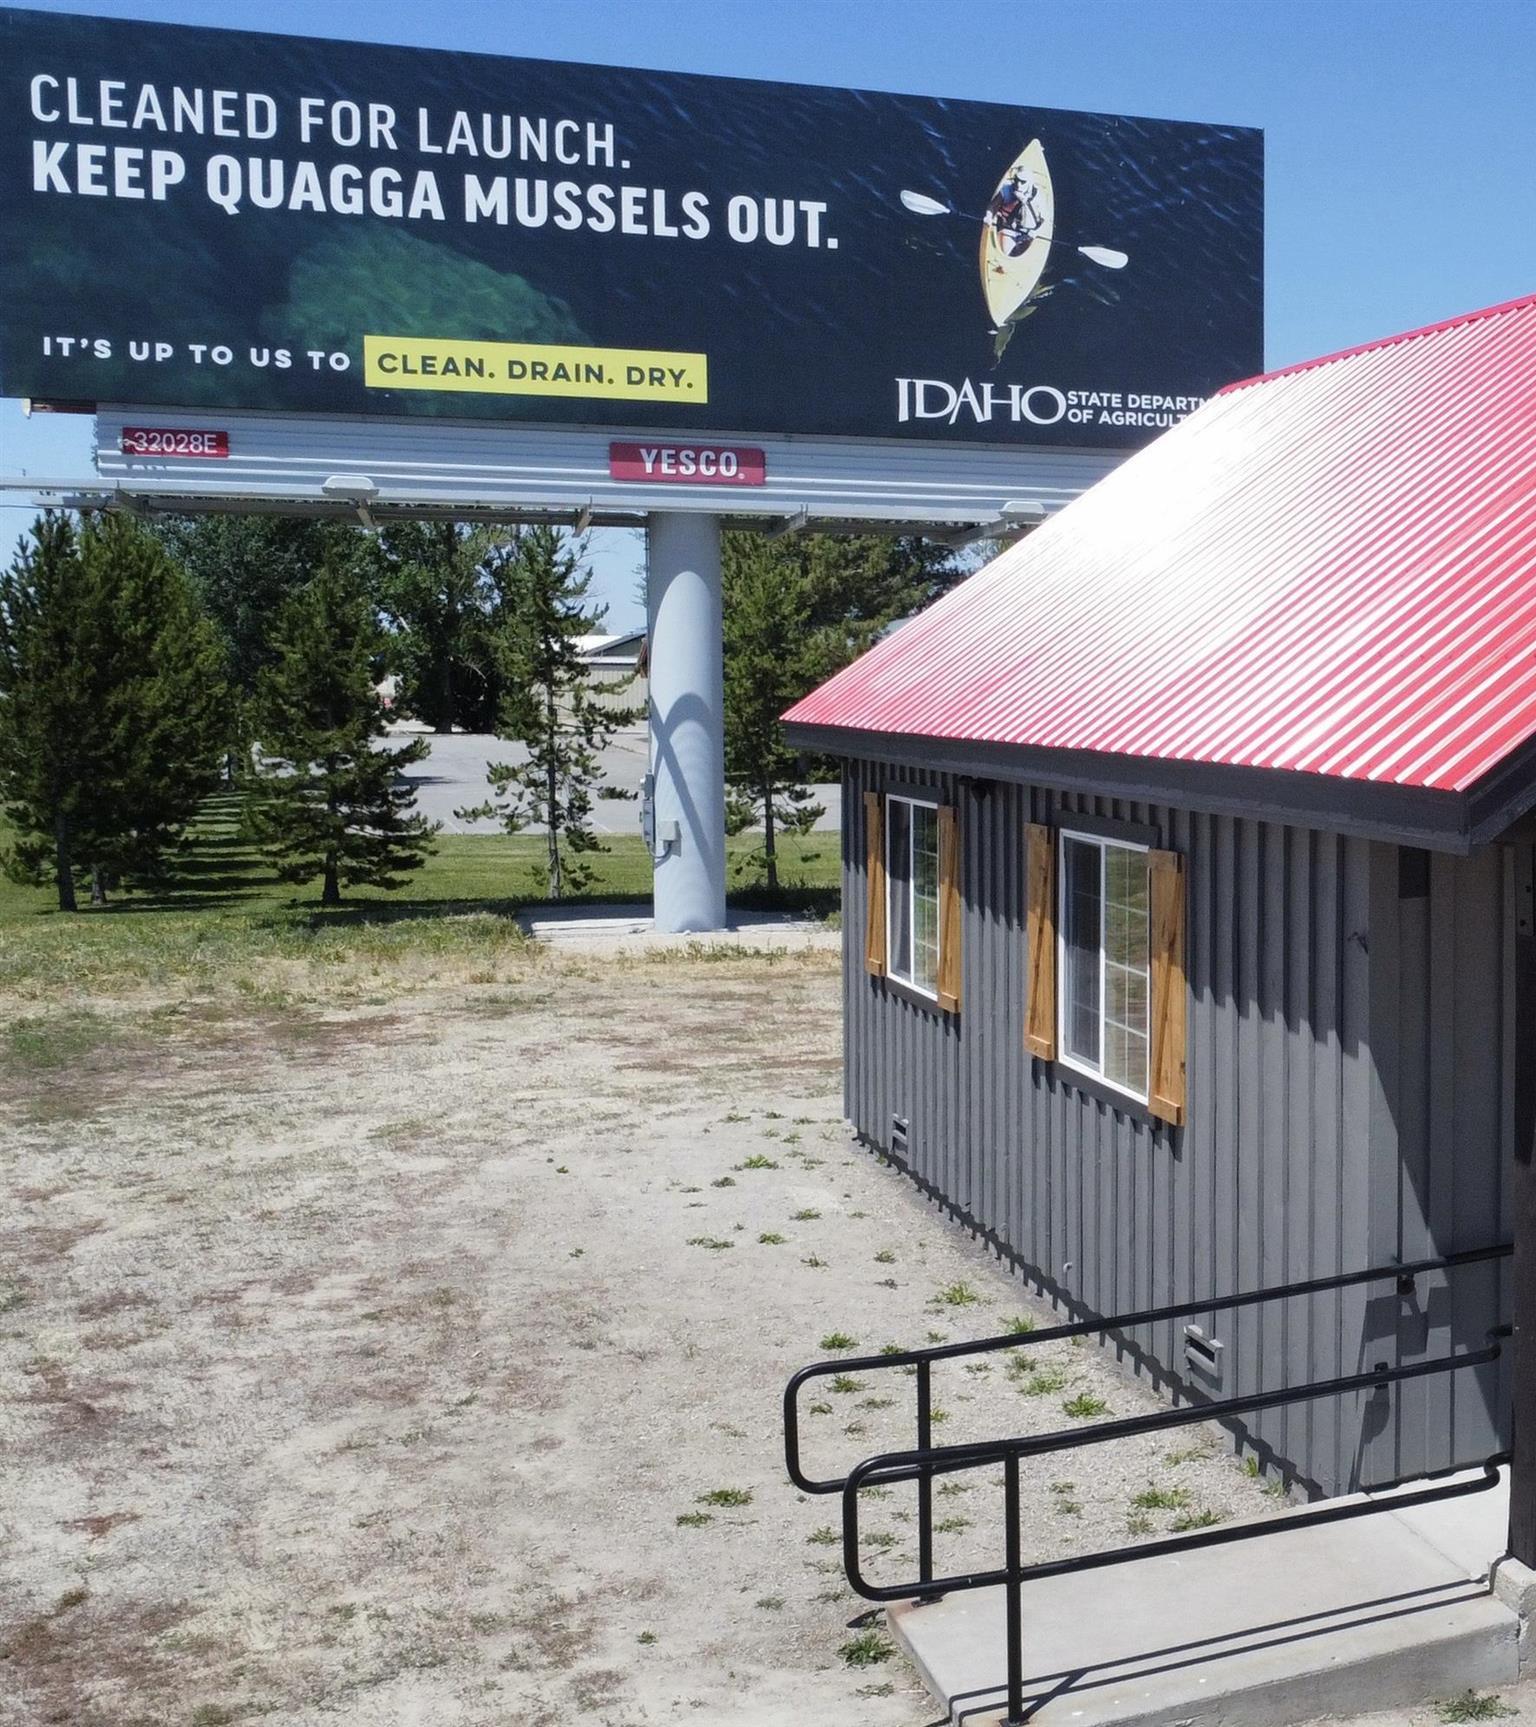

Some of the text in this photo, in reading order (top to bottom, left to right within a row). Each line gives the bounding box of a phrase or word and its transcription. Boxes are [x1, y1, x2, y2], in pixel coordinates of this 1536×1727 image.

[31, 74, 630, 169] CLEANED FOR LAUNCH.
[33, 140, 838, 249] KEEP QUAGGA MUSSELS OUT.
[44, 337, 694, 388] IT'S UP TO US TO CLEAN. DRAIN. DRY.
[895, 377, 1066, 425] IDAHO
[1067, 391, 1122, 408] STATE
[1067, 408, 1093, 424] OF
[133, 431, 218, 454] 32028E
[640, 448, 738, 477] YESCO
